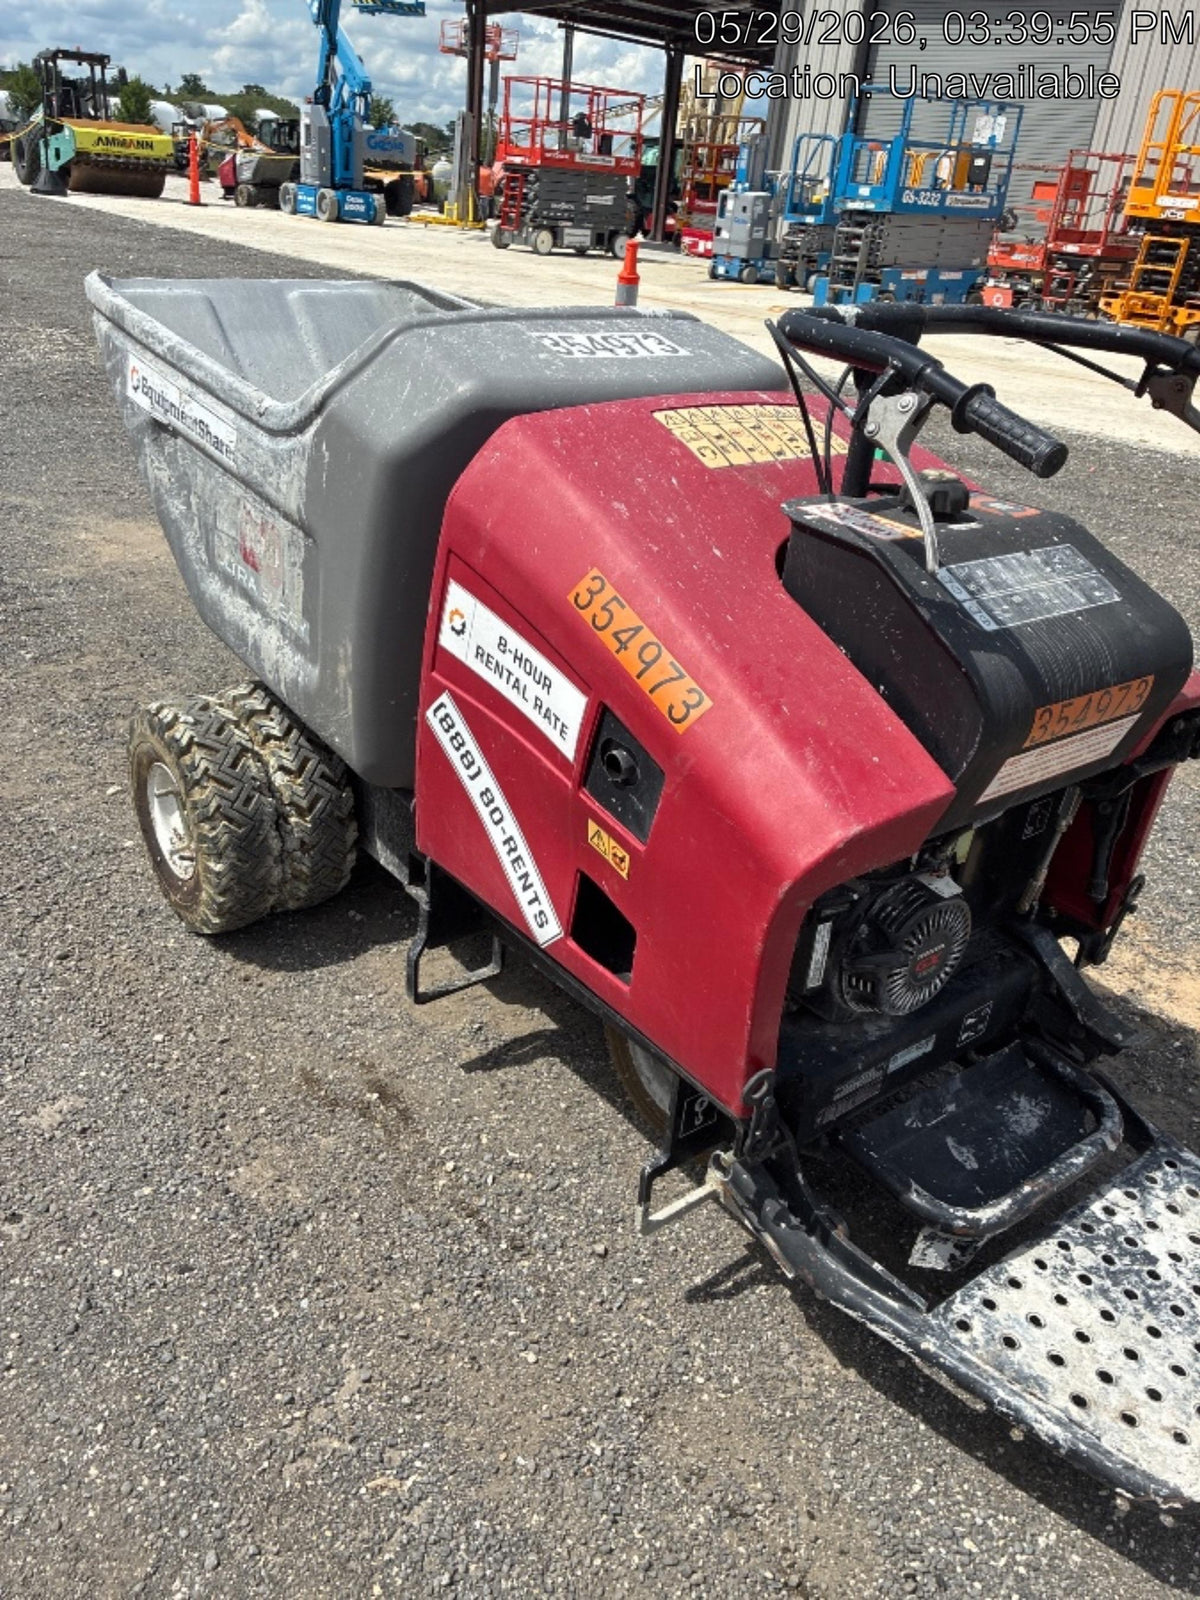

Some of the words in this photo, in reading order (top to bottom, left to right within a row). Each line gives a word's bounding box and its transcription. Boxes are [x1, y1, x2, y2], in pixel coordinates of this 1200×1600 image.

[94, 136, 154, 151] AMMANN
[1160, 209, 1185, 220] JCB
[536, 333, 680, 356] 354973
[497, 636, 552, 695] 8-HOUR
[573, 575, 705, 724] 354973
[474, 645, 529, 702] RENTAL
[532, 696, 568, 741] RATE
[1030, 679, 1149, 744] 354973
[433, 701, 482, 781] (888)
[479, 787, 549, 929] 80-RENTS
